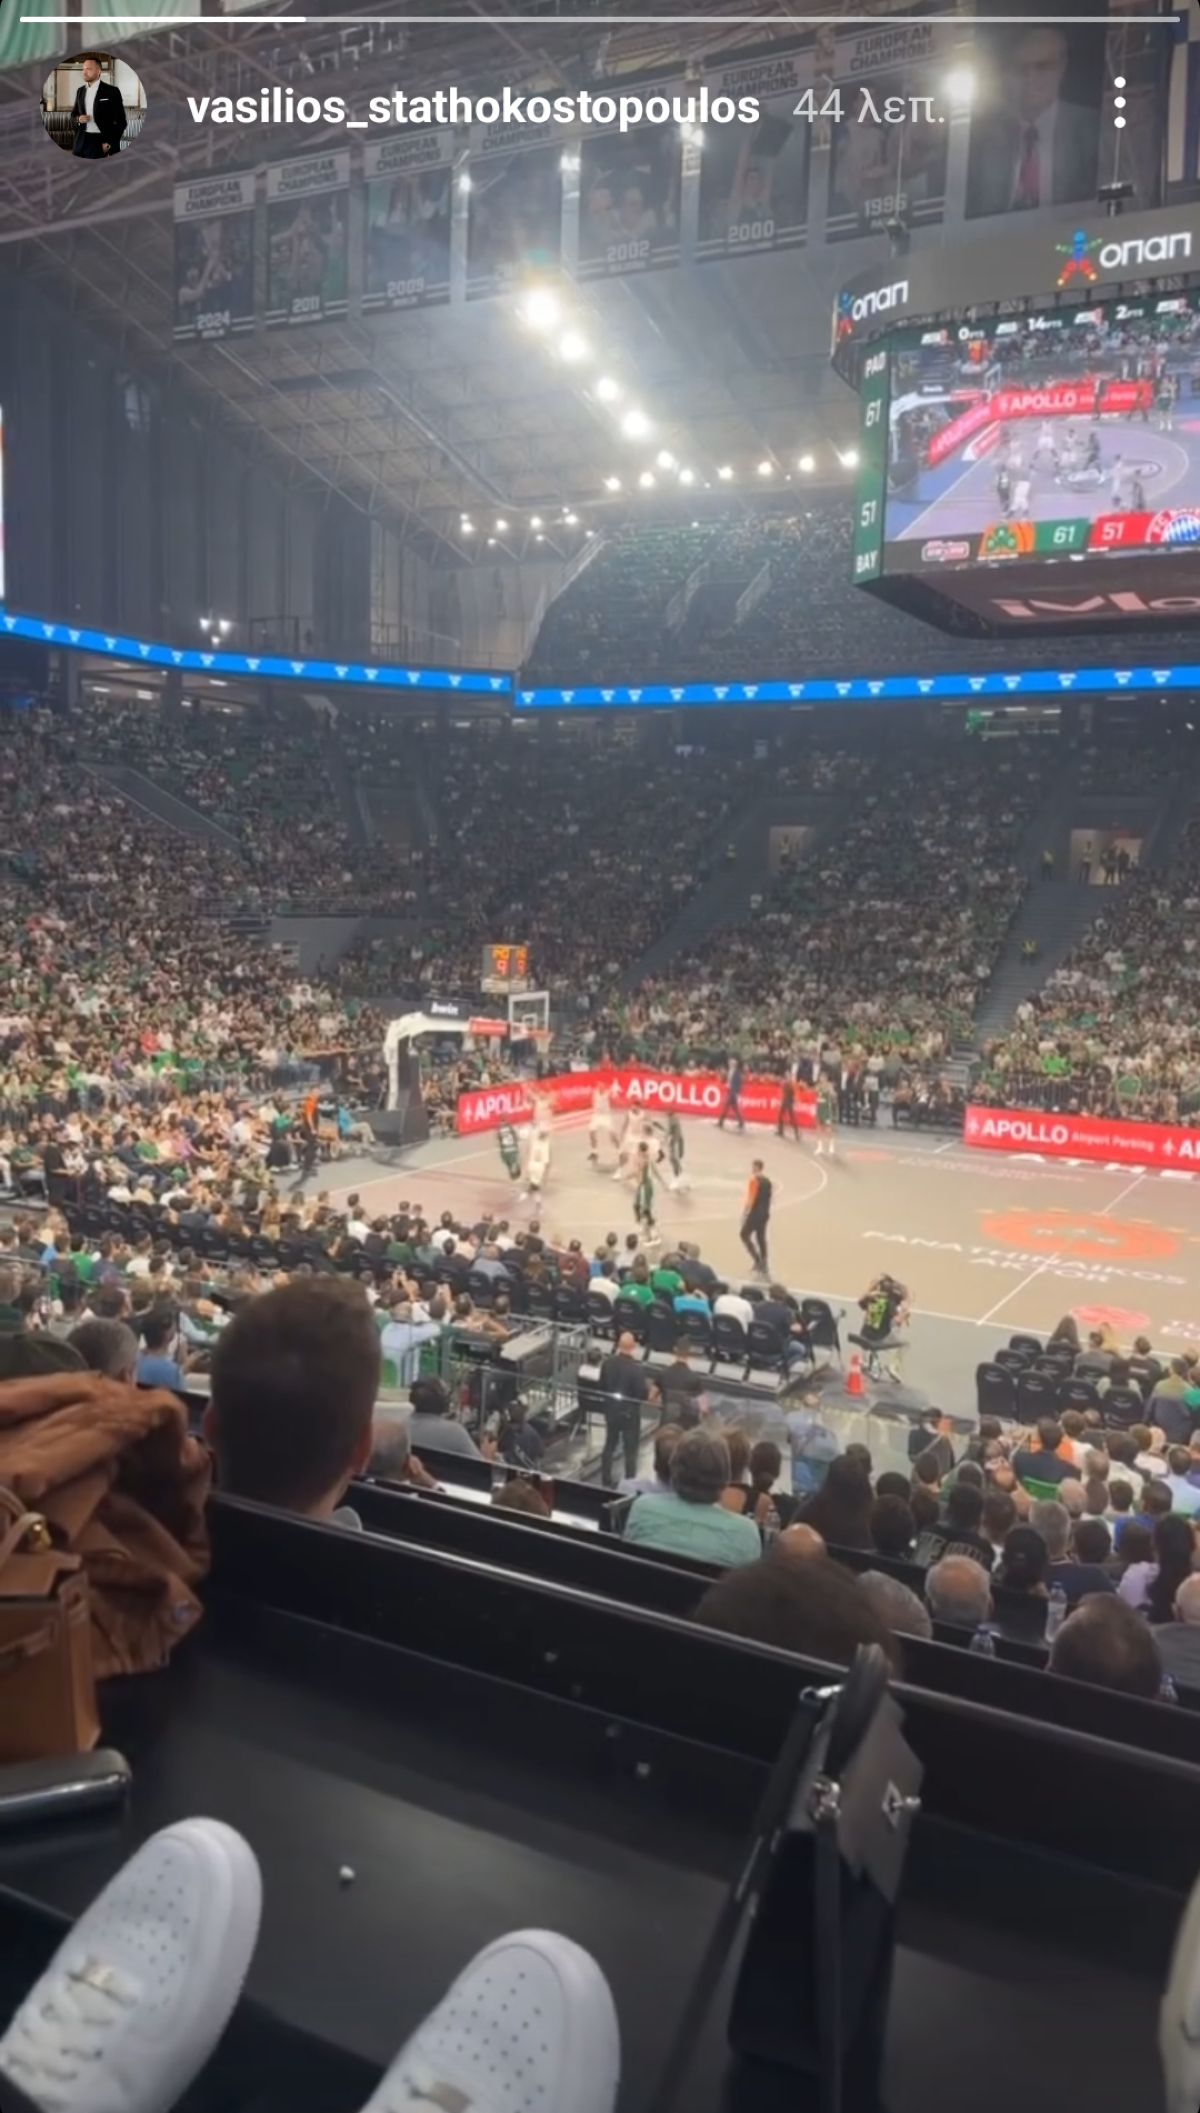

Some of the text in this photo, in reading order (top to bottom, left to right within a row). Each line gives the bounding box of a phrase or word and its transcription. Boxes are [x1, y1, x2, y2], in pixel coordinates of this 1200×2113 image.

[856, 23, 933, 54] EUROPEAN
[850, 40, 936, 71] CHAMPIONS
[722, 60, 794, 87] EUROPEAN
[717, 73, 798, 99] CHAMPIONS
[379, 135, 438, 159] EUROPEAN
[188, 180, 241, 200] EUROPEAN
[863, 192, 908, 217] 1996
[727, 219, 775, 243] 2000
[607, 240, 650, 263] 2002
[387, 276, 424, 298] 2009
[292, 296, 320, 313] 2011
[197, 309, 230, 330] 2024
[864, 398, 881, 428] 61
[1011, 391, 1077, 411] APOLLO
[860, 500, 877, 527] 51
[1053, 524, 1075, 544] 61
[1102, 521, 1125, 541] 51
[856, 549, 878, 574] BAY
[626, 1078, 721, 1108] APOLLO
[981, 1117, 1155, 1153] APOLLO Airport Parking
